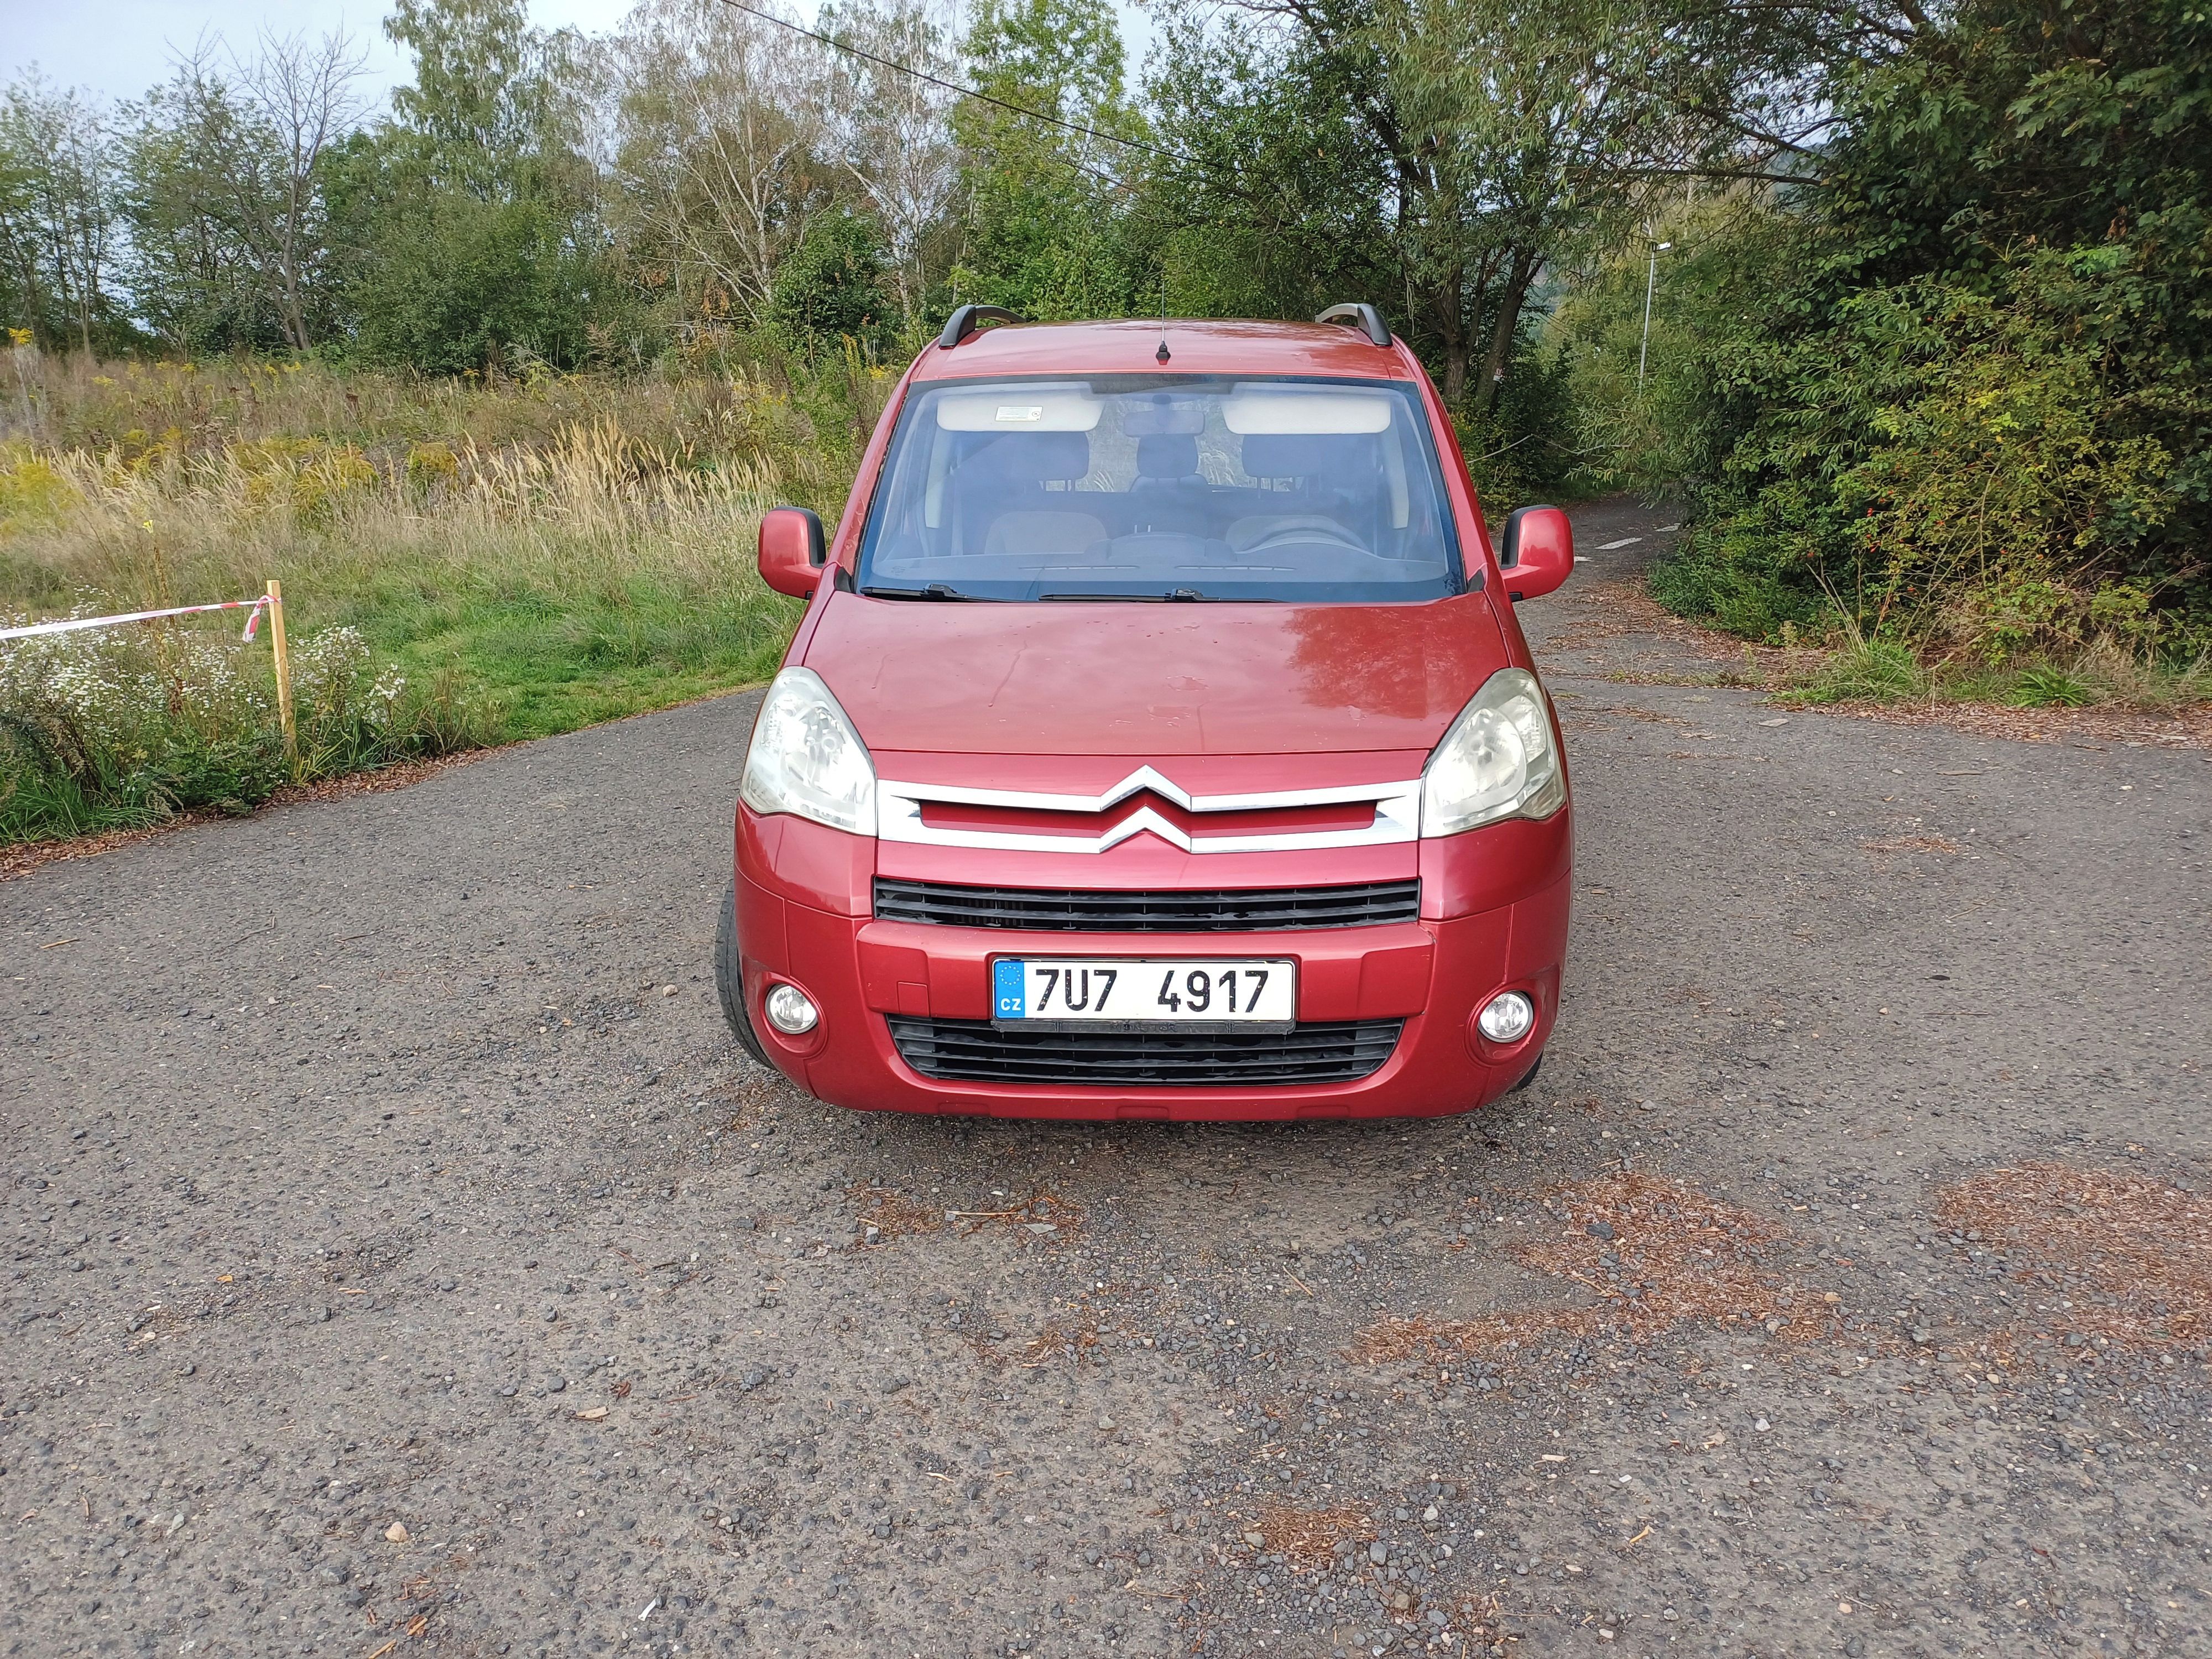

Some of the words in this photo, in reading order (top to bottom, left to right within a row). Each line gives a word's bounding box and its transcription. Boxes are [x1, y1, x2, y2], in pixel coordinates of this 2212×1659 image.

[1000, 998, 1021, 1011] CZ
[1036, 969, 1117, 1011] 7U7
[1157, 970, 1269, 1013] 4917
